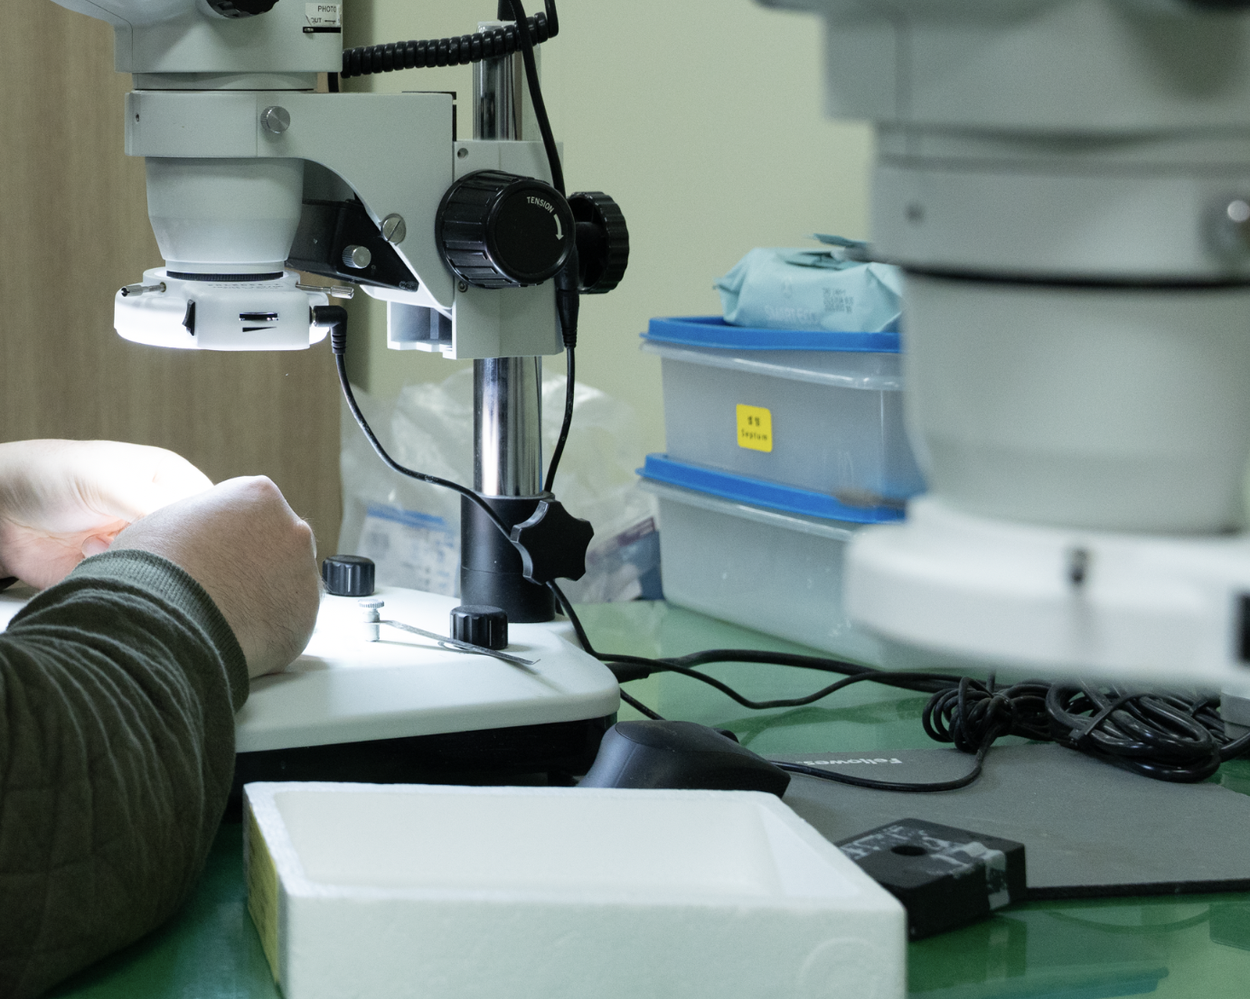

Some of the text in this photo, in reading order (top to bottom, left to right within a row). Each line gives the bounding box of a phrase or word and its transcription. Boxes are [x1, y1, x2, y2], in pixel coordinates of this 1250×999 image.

[317, 5, 337, 13] PHOTO
[526, 196, 555, 214] TENSION
[803, 757, 903, 765] Fellowes
